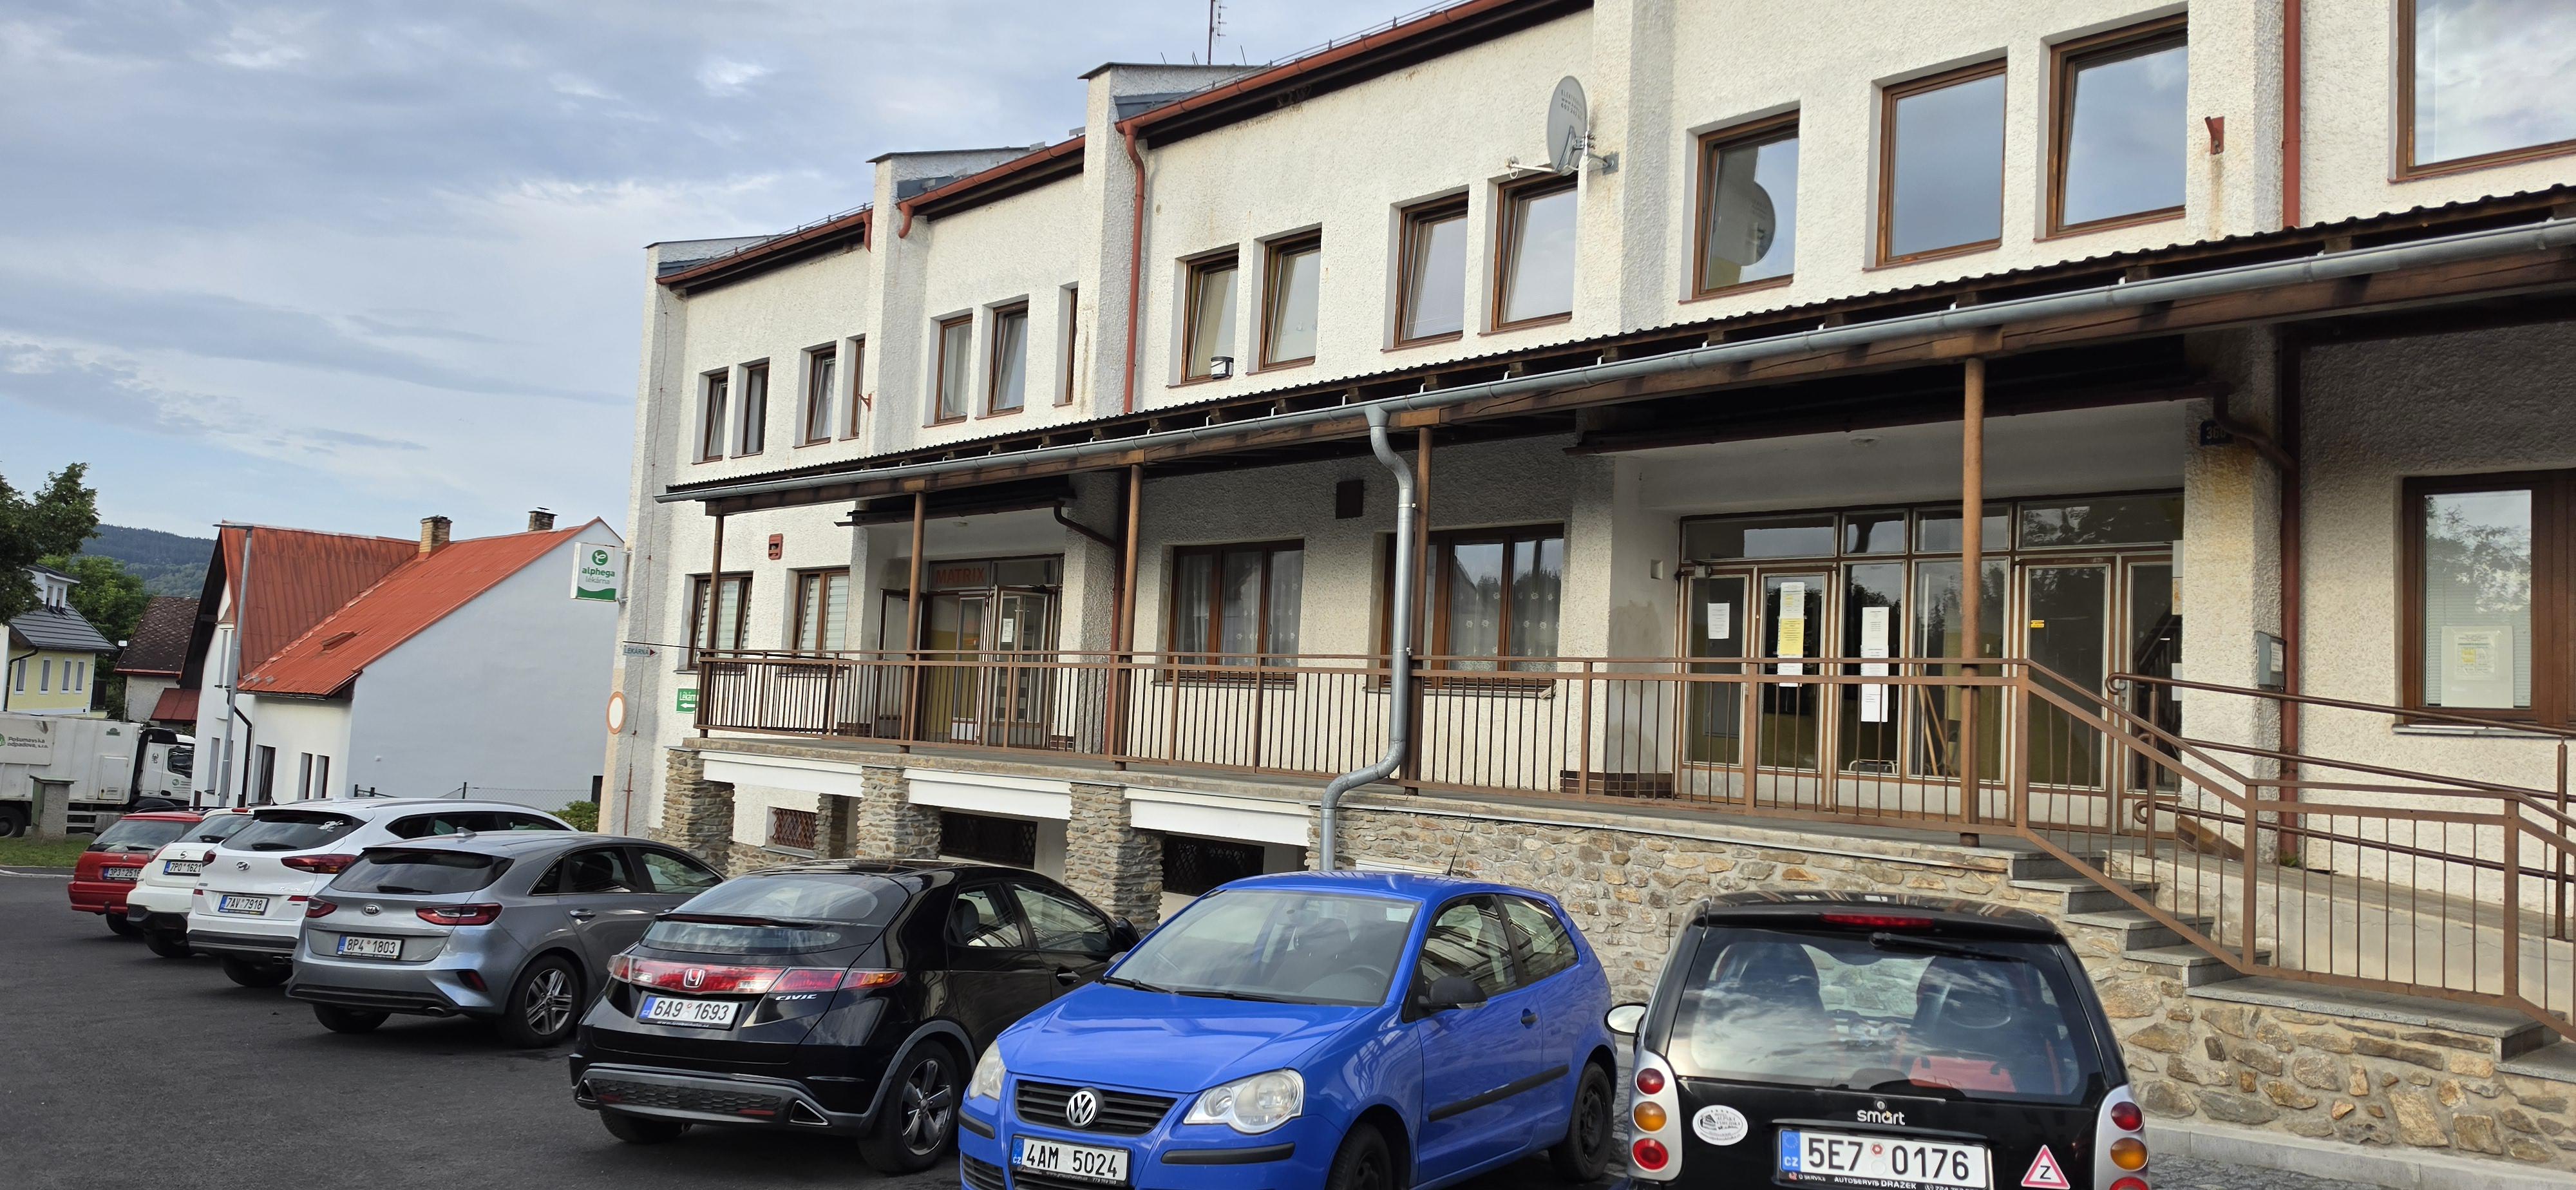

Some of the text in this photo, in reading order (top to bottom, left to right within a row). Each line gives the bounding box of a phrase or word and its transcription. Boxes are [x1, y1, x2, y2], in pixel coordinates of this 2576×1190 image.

[582, 567, 615, 578] alphega
[936, 567, 985, 584] MATRIX
[585, 576, 610, 585] lékárna
[187, 863, 202, 873] 1621
[226, 898, 240, 908] 7AV
[243, 899, 263, 910] 7918
[346, 938, 364, 952] 8P4
[372, 940, 395, 954] 1803
[654, 1000, 683, 1017] 6A9
[694, 1003, 730, 1021] 1693
[1857, 1109, 1906, 1126] smart
[1013, 1144, 1117, 1178] CZ 4AM 5024
[1784, 1137, 1969, 1181] CZ 5E7 0176
[2039, 1165, 2052, 1180] Z
[1834, 1176, 1879, 1186] AUTOSERVIS
